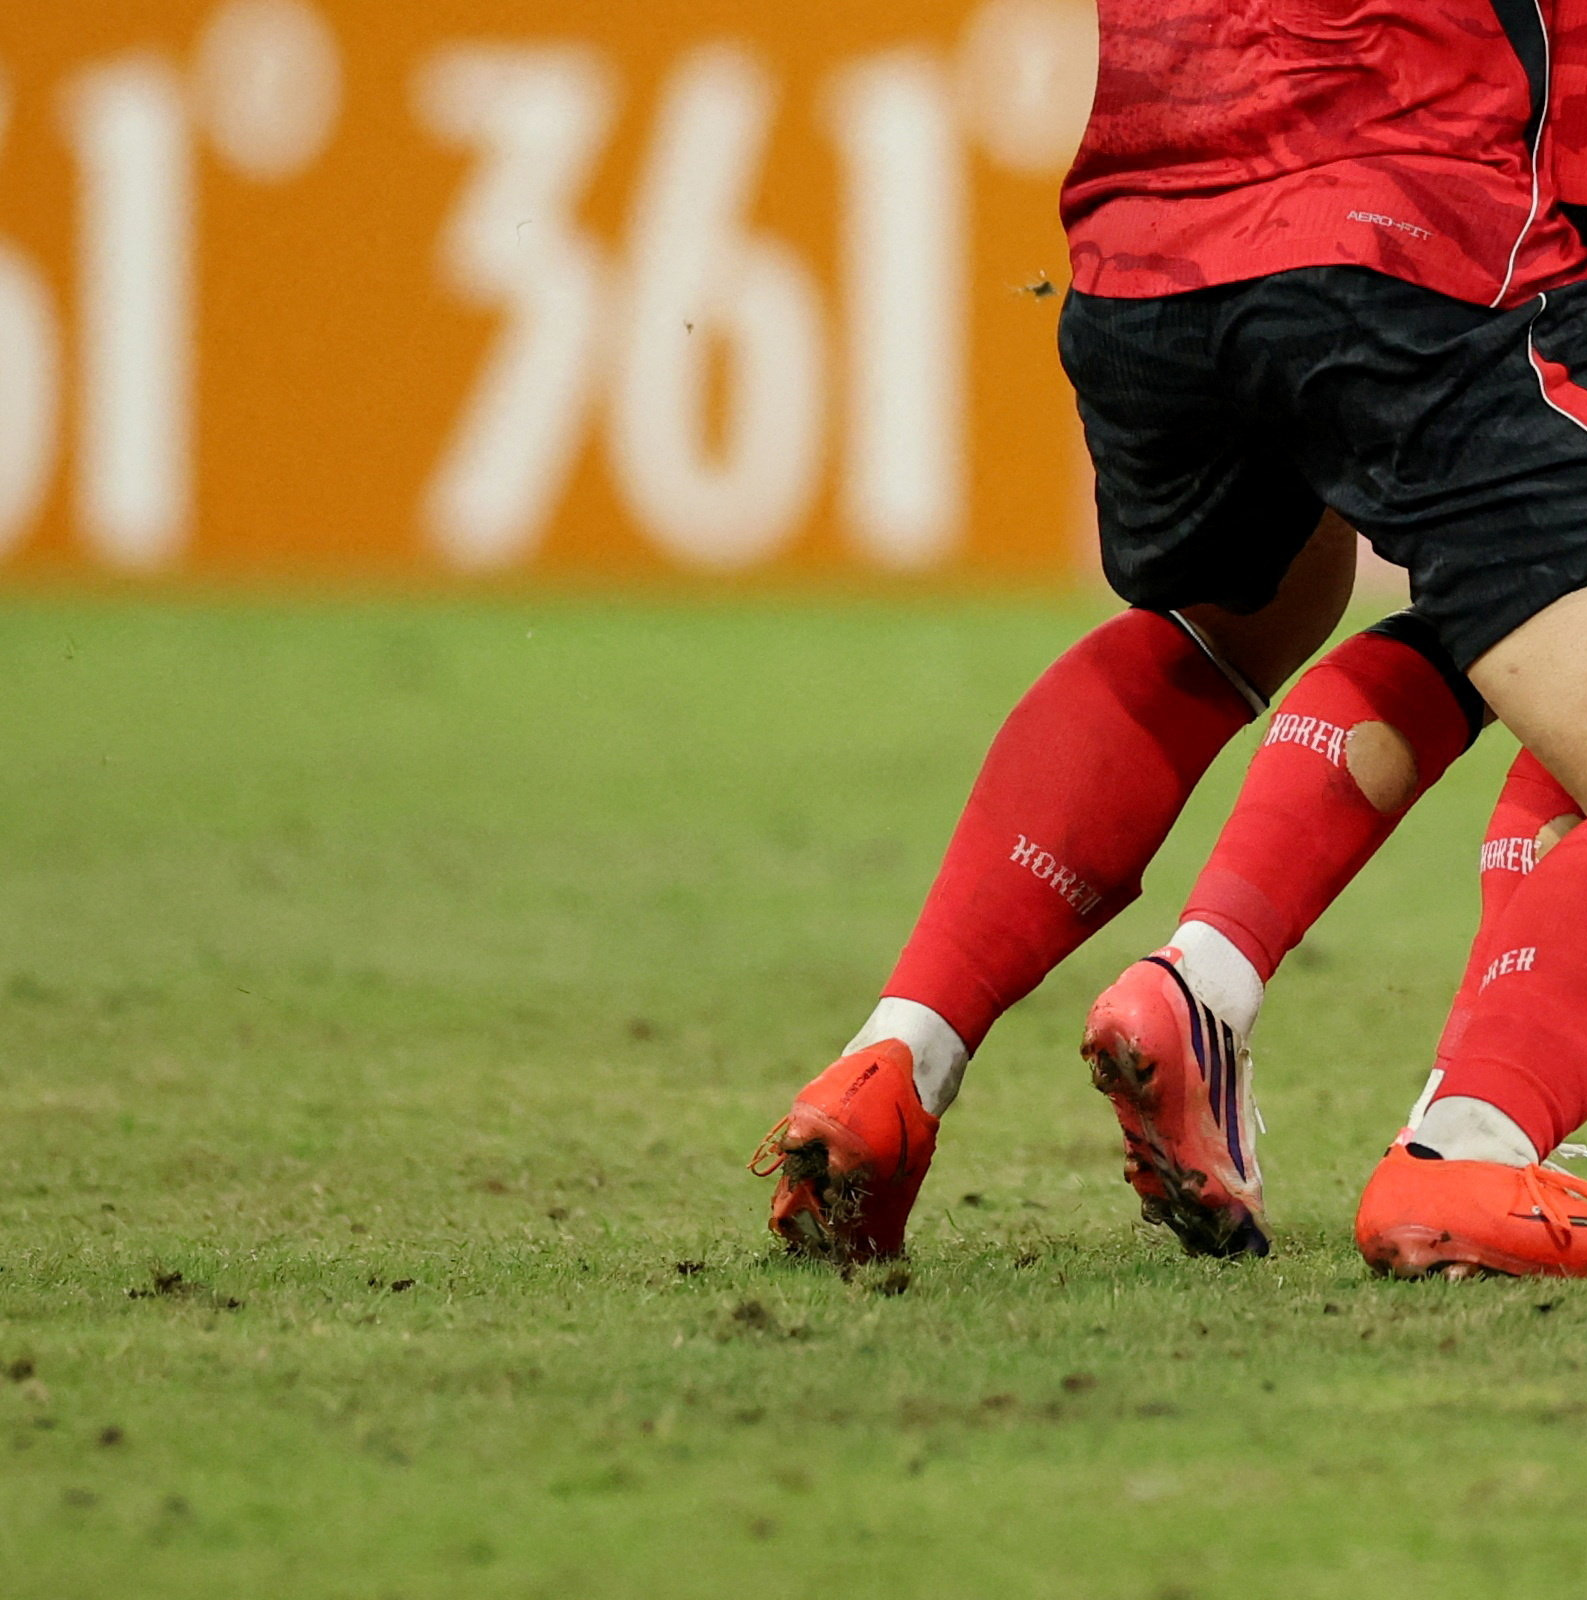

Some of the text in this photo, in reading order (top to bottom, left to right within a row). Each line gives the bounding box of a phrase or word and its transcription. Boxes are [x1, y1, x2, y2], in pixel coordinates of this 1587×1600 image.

[1345, 209, 1433, 241] AERO-FIT
[1264, 713, 1345, 768] KOREA
[1479, 837, 1535, 875] KOREA
